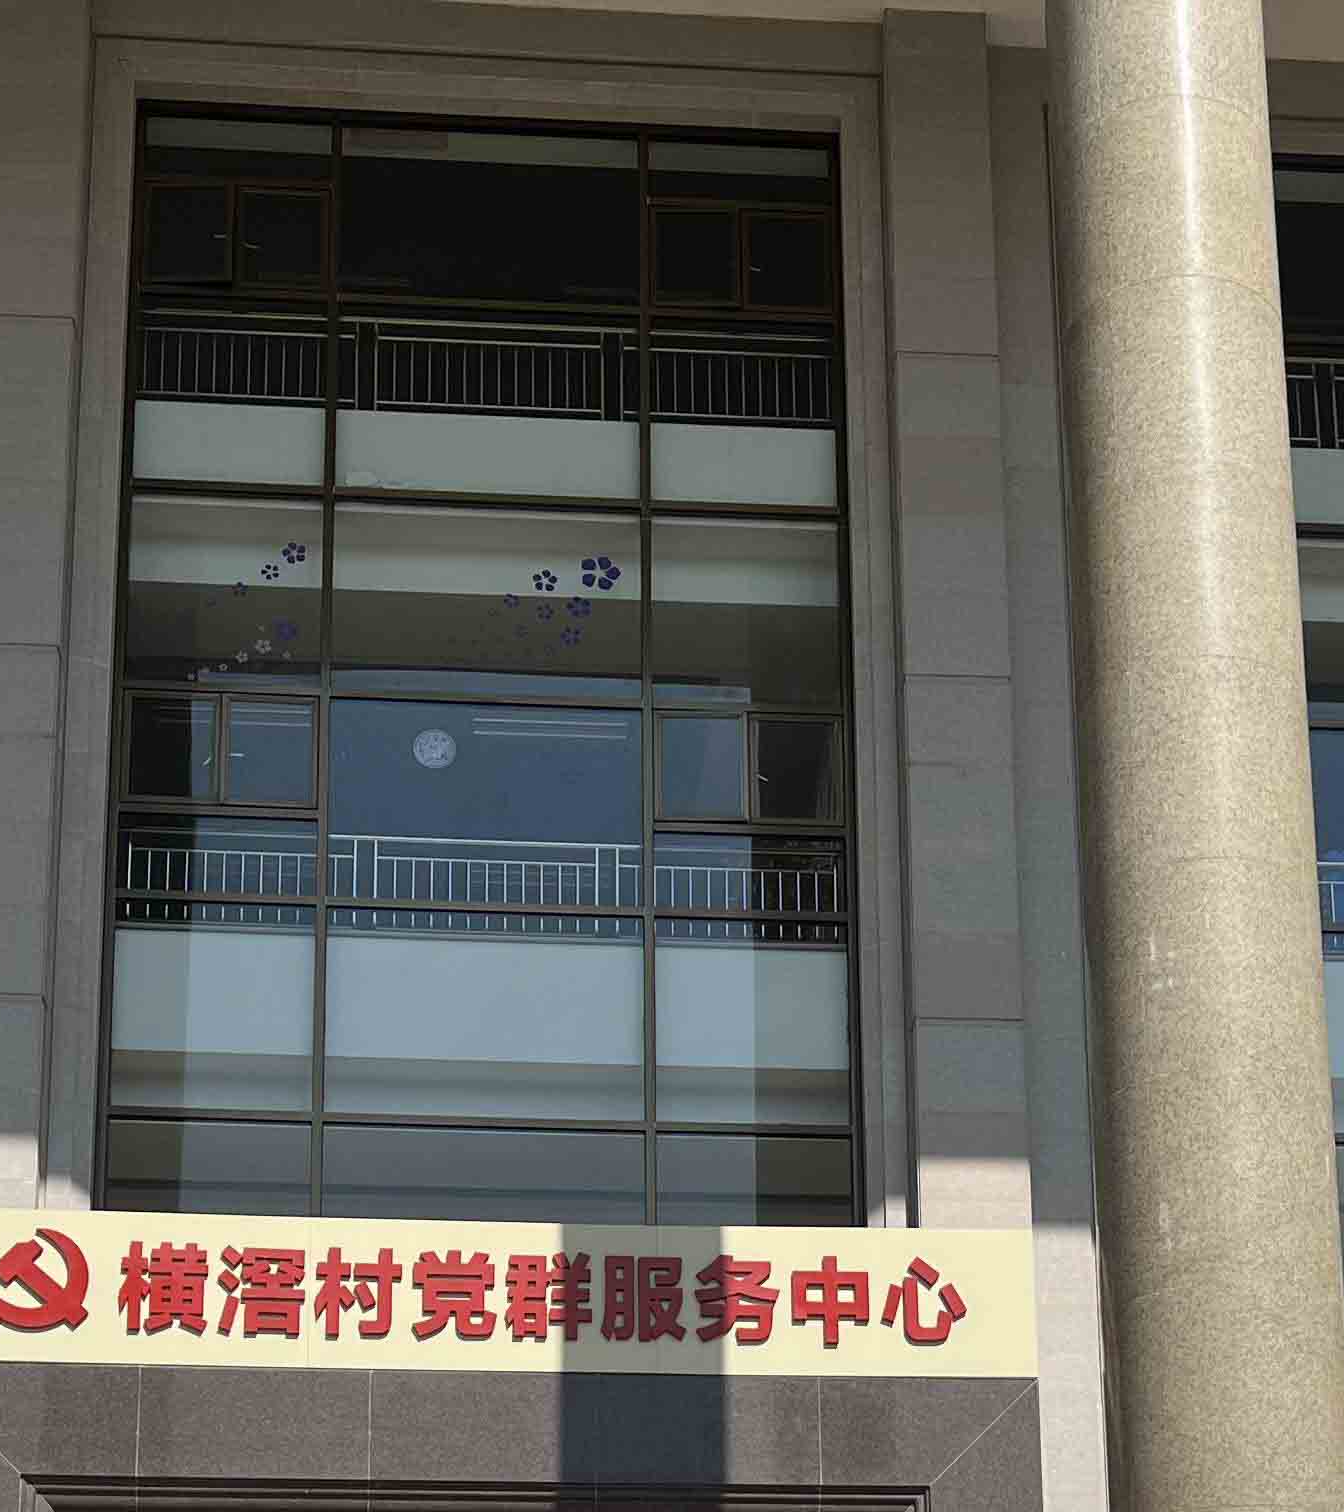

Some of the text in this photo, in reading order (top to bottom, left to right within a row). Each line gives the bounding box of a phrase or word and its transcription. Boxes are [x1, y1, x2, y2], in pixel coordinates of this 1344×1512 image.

[118, 1240, 967, 1347] 横滘村党群服务中心
